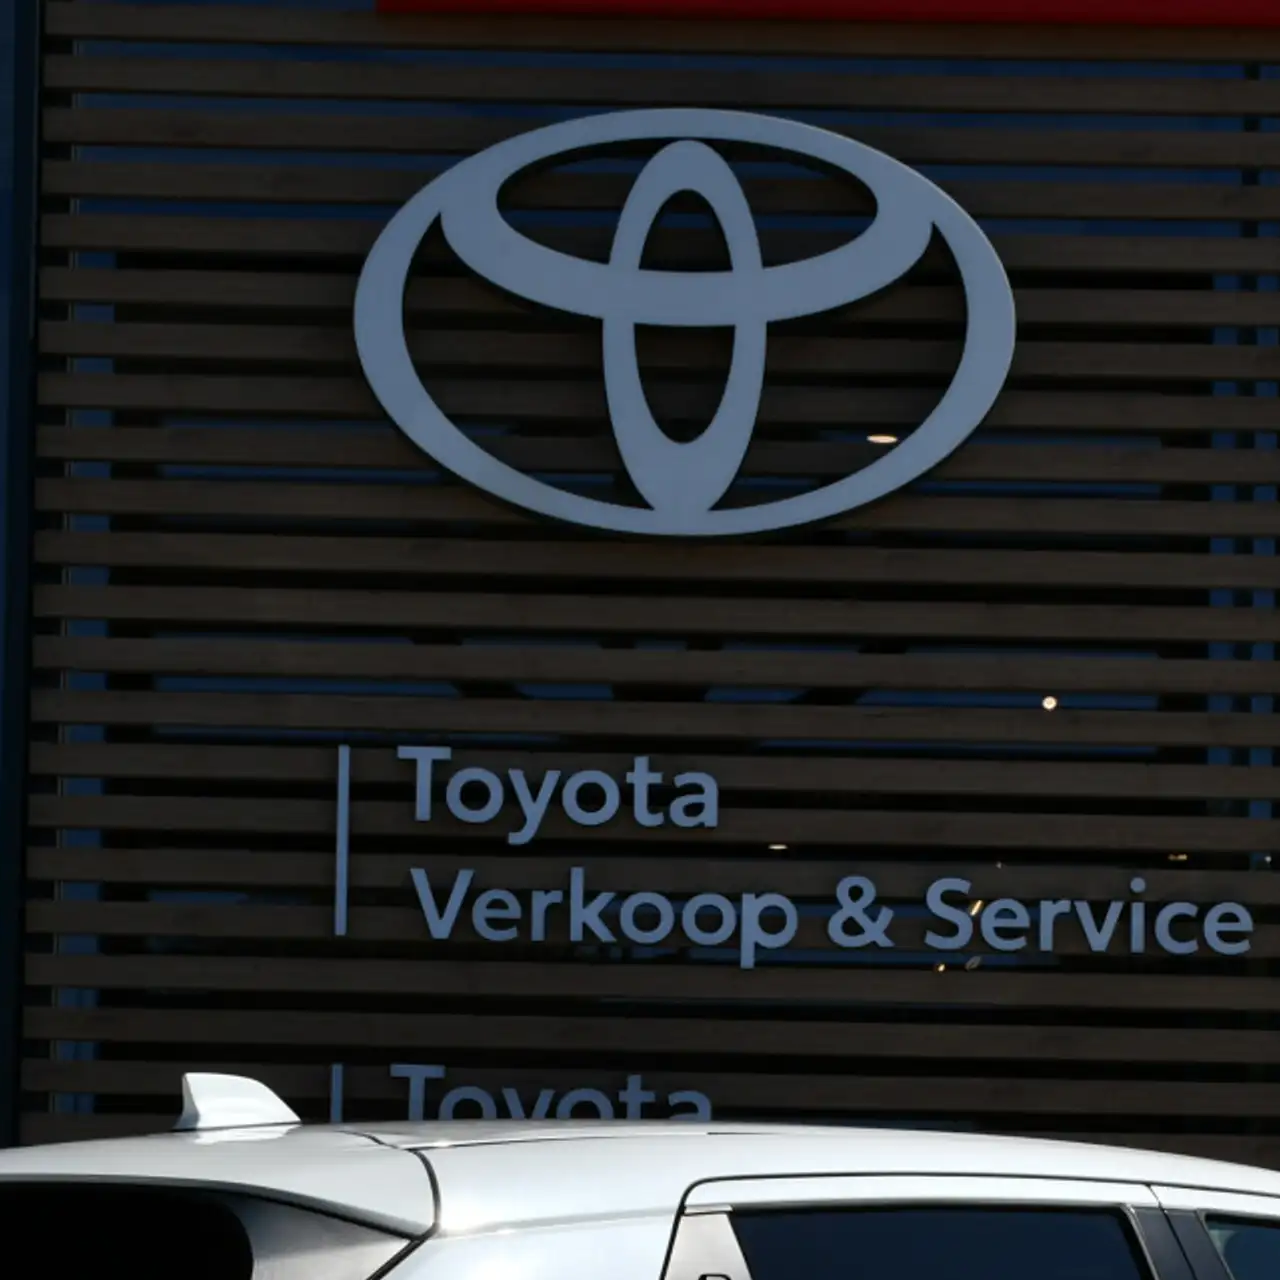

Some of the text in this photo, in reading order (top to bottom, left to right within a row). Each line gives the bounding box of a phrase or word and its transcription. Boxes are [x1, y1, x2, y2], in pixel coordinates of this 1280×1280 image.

[396, 745, 720, 846] Toyota
[410, 867, 1254, 969] Verkoop & Service
